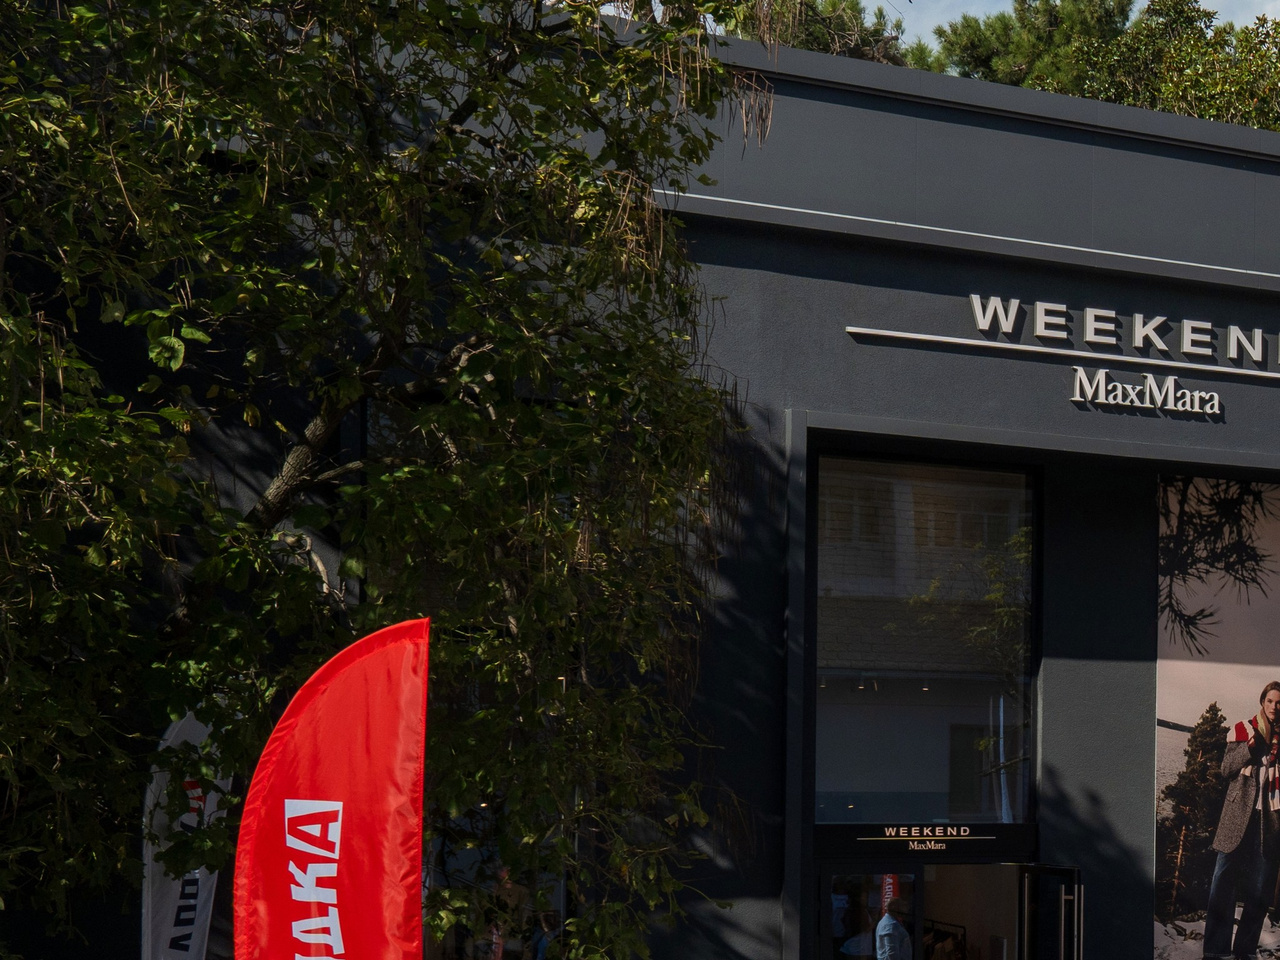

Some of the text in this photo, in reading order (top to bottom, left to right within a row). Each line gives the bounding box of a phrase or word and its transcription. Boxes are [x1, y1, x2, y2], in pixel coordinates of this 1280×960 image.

[1070, 365, 1221, 415] MaxMara
[885, 827, 970, 836] WEEKEND
[908, 840, 946, 850] MaxMara
